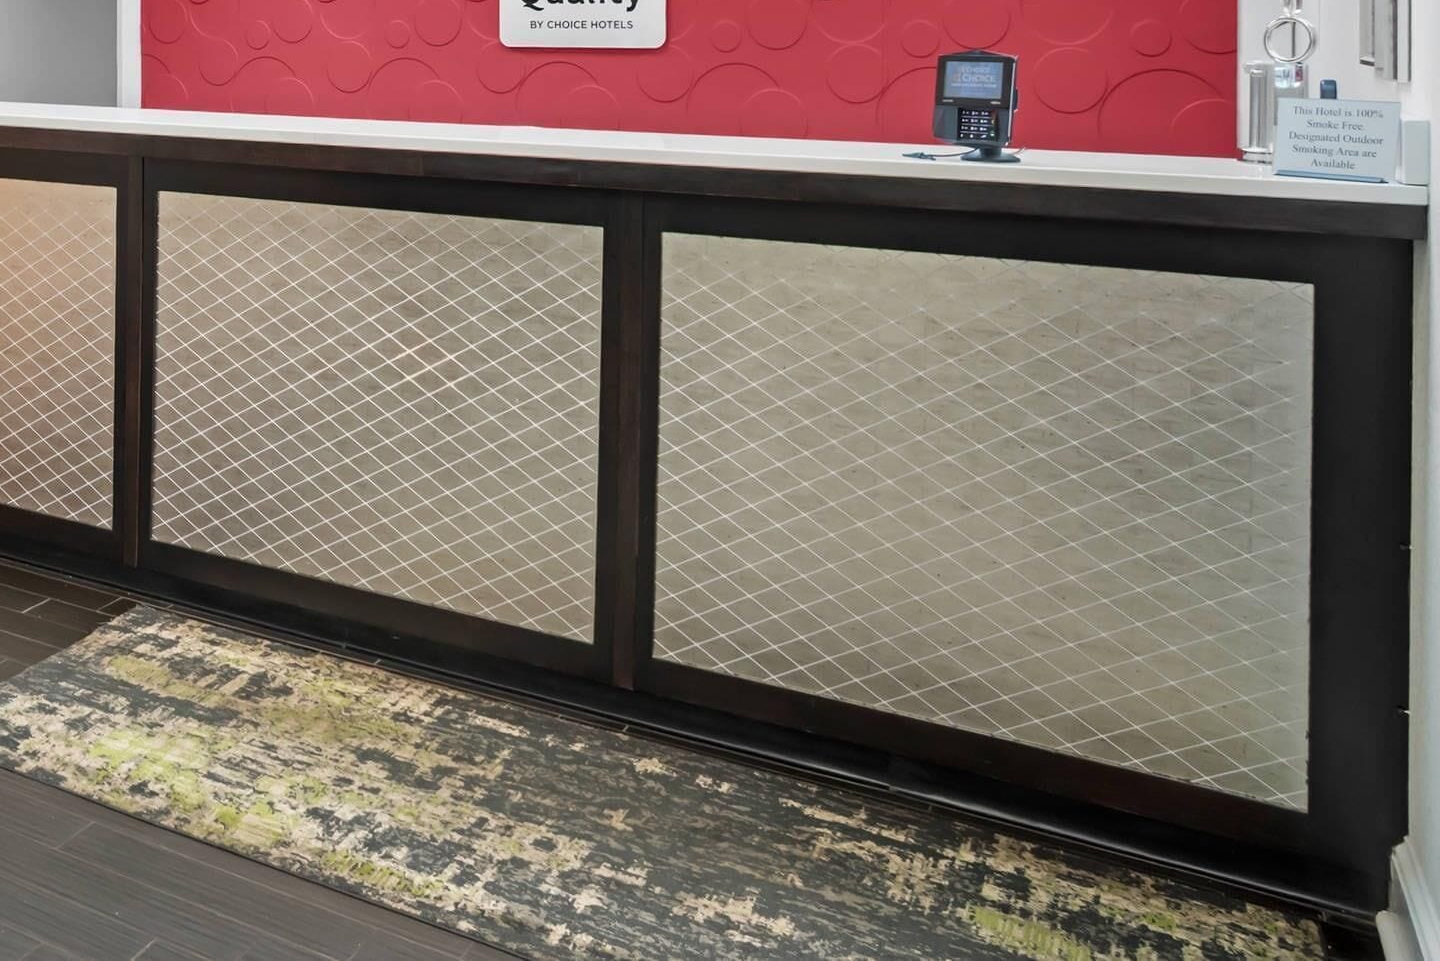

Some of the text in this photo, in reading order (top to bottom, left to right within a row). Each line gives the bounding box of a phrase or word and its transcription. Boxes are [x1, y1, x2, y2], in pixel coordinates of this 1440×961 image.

[530, 20, 634, 29] BY CHOICE HOTELS
[1293, 105, 1384, 118] This Hotel is 100%
[1306, 119, 1339, 130] Smoke
[1288, 130, 1384, 145] Designated Outdoor
[1292, 144, 1377, 158] Smoking Area are
[1310, 158, 1356, 170] Available
